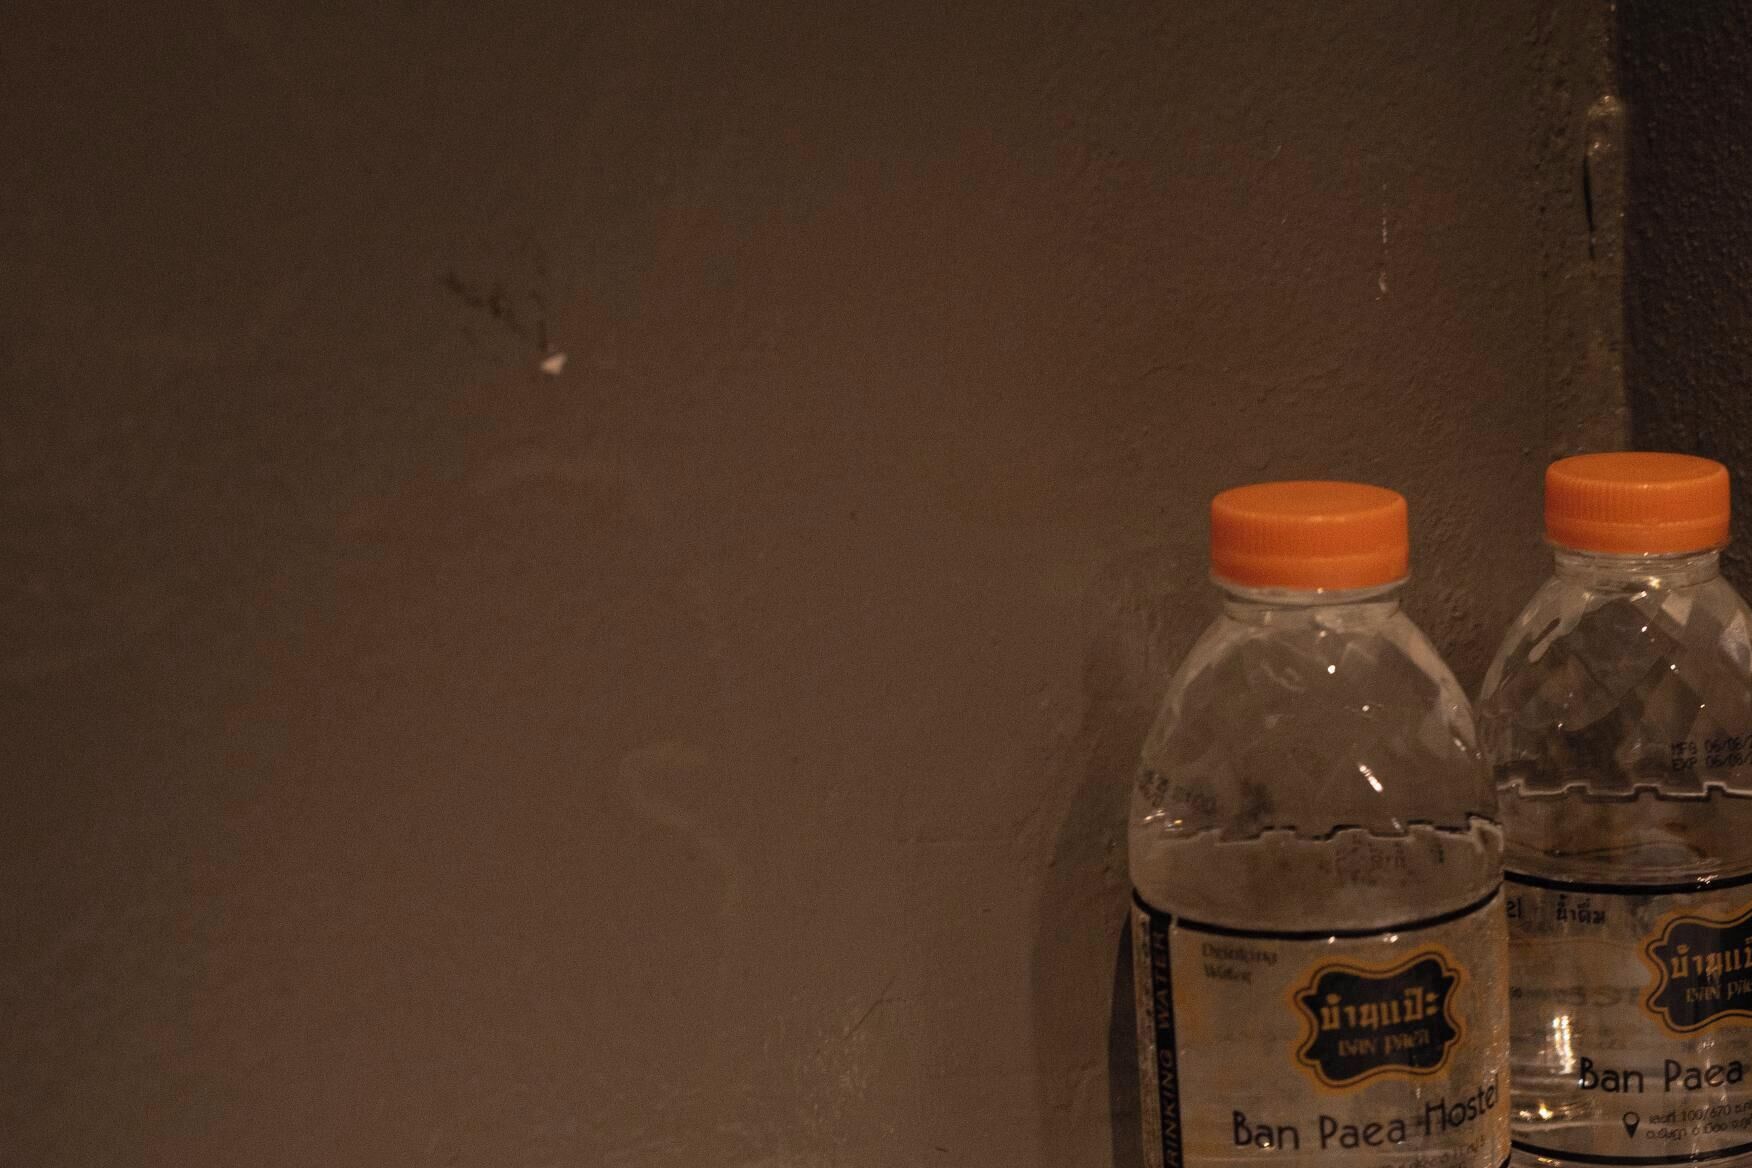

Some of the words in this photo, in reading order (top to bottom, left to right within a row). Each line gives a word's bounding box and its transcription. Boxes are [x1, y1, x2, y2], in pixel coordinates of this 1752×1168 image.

[1671, 756, 1698, 772] EXP
[1153, 931, 1172, 1029] WATER
[1579, 1056, 1644, 1094] Ban
[1663, 1058, 1744, 1093] Paea
[1233, 1110, 1300, 1150] Ban
[1319, 1113, 1407, 1150] Paea
[1421, 1072, 1500, 1136] Hostel
